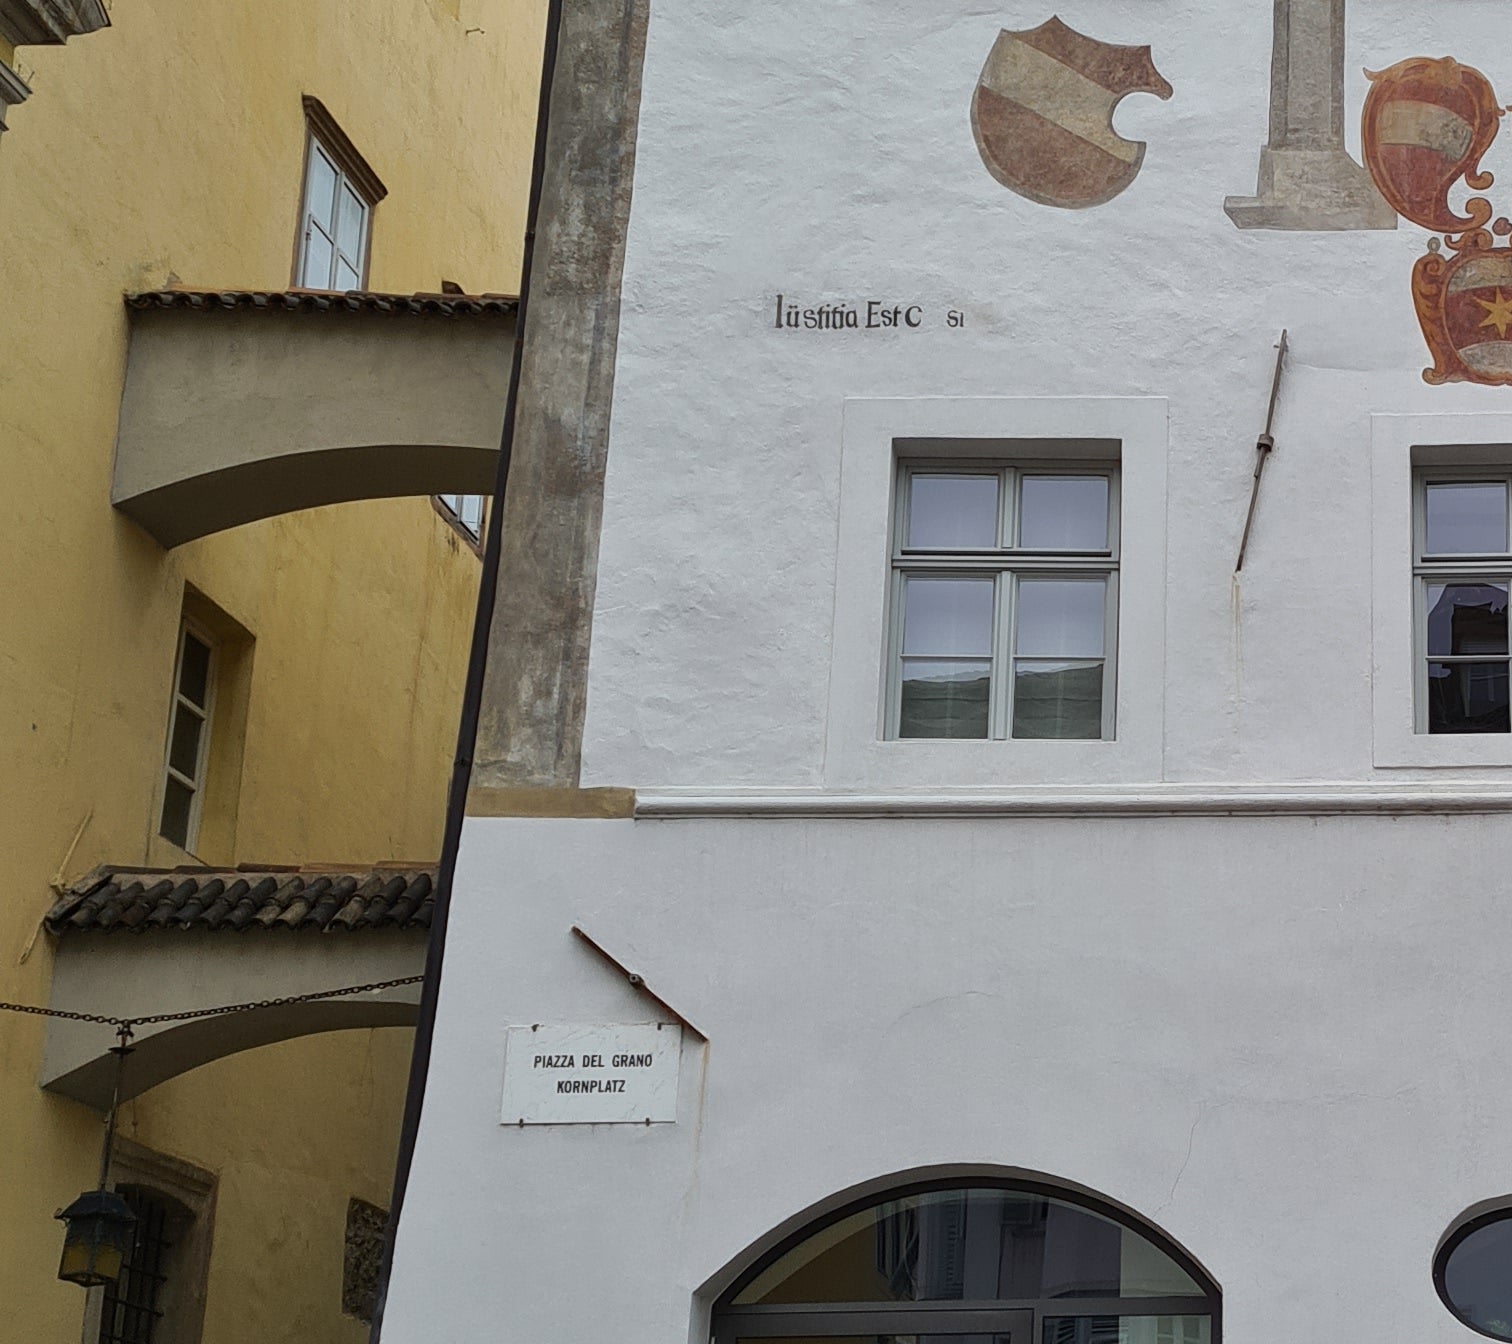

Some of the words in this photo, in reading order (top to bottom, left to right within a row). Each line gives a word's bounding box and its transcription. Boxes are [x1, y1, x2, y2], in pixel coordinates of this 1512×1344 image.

[865, 301, 902, 328] Est
[533, 1055, 575, 1068] PIAZZA
[582, 1055, 605, 1068] DEL
[612, 1053, 653, 1068] GRANO
[556, 1080, 626, 1094] KORNPLATZ
